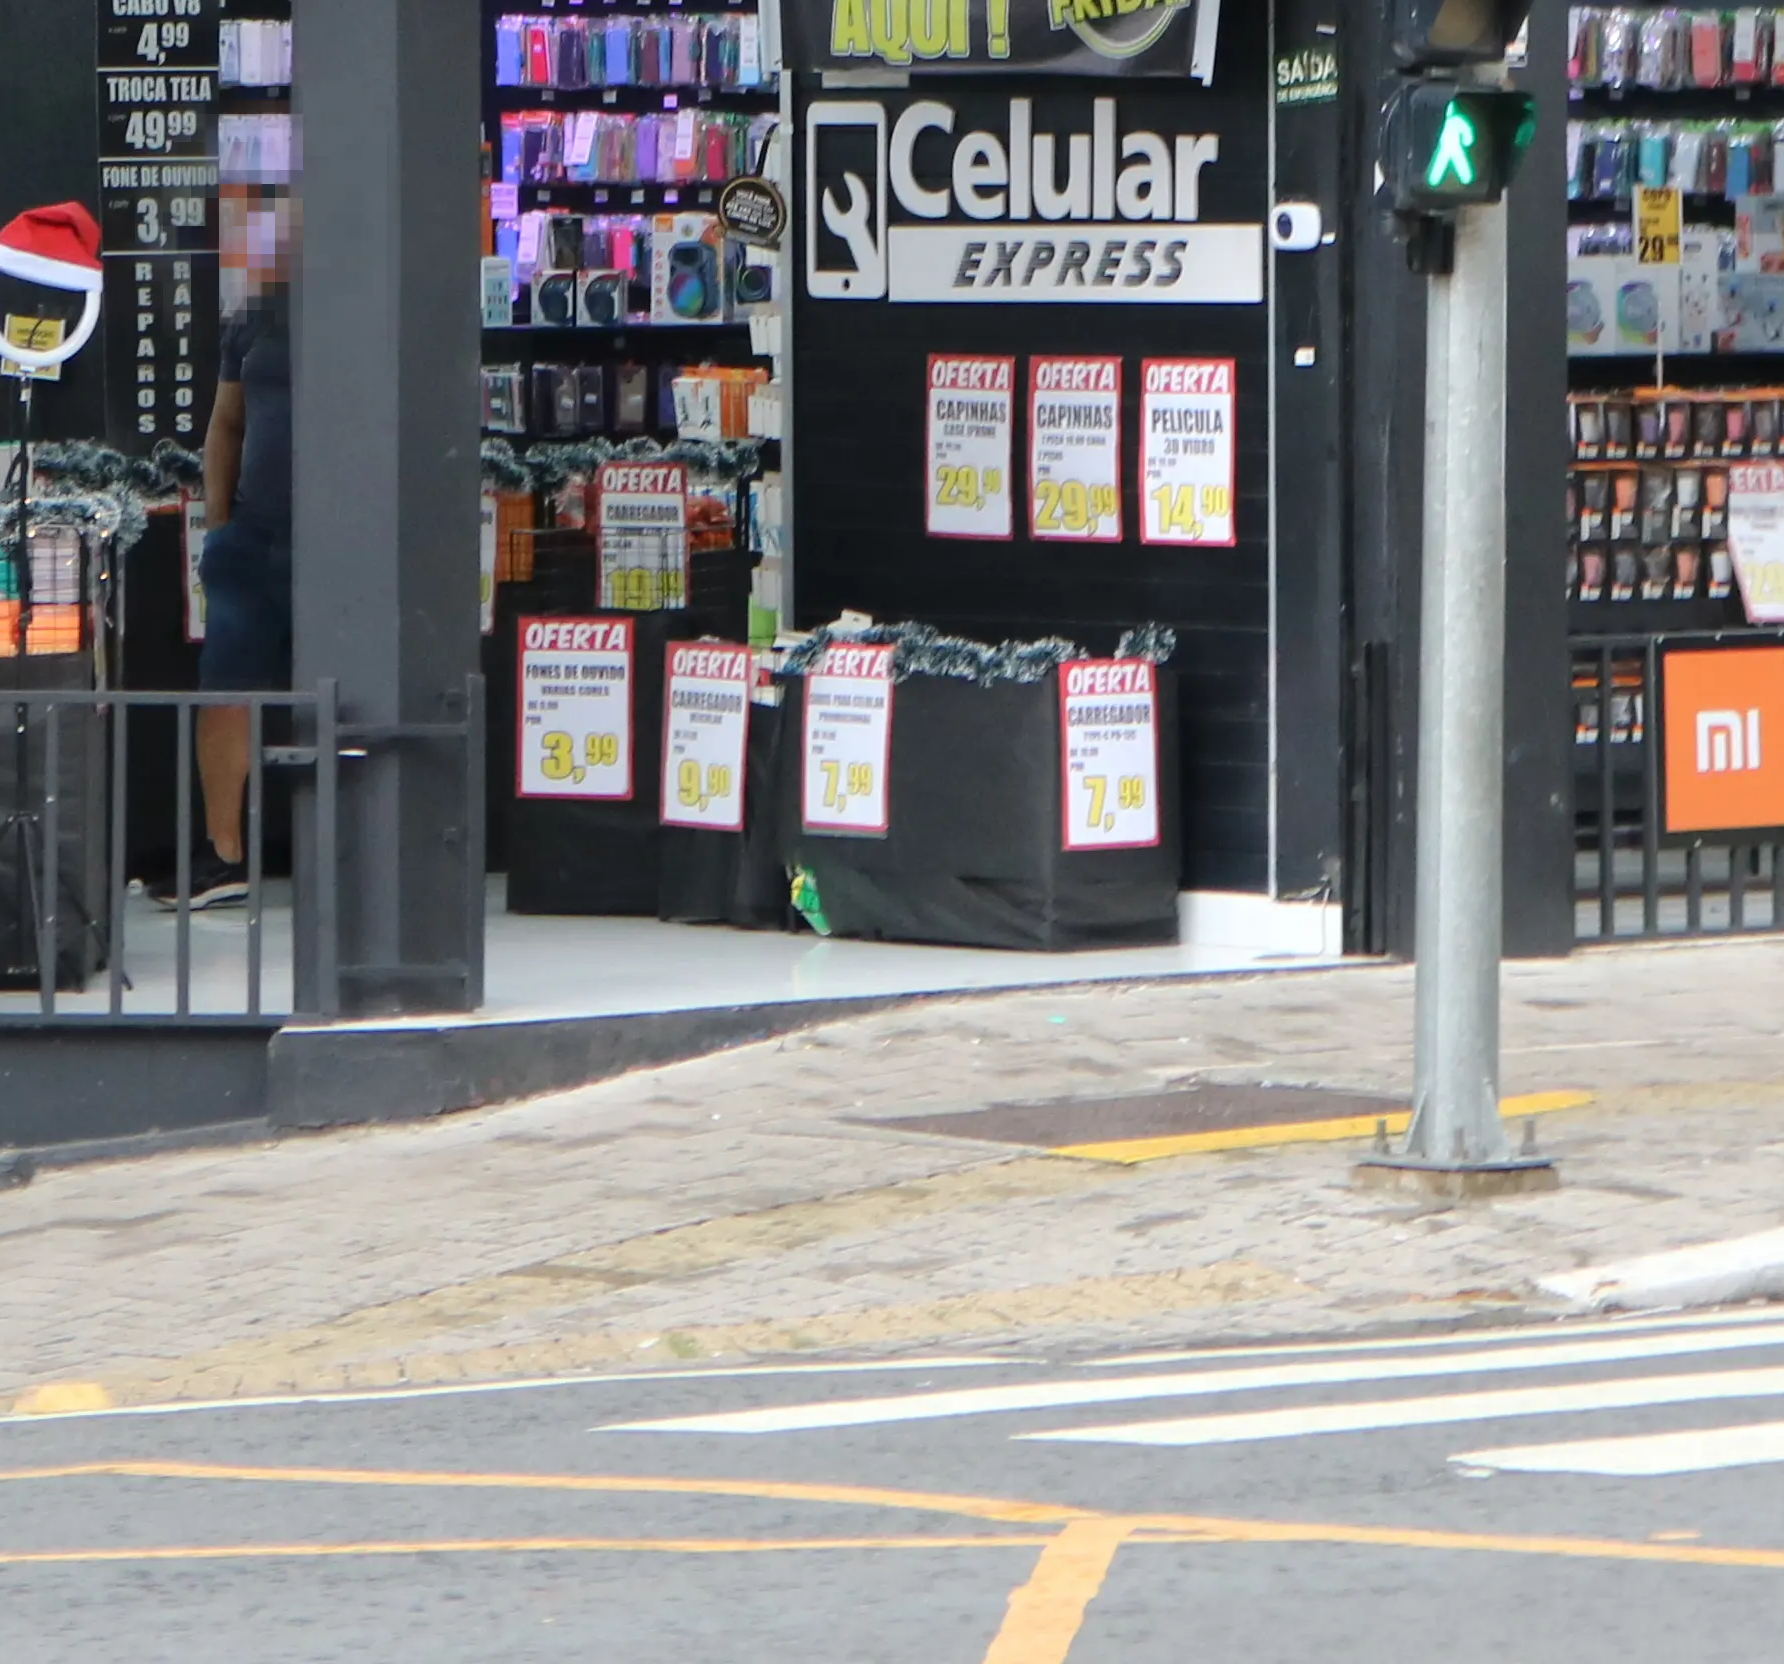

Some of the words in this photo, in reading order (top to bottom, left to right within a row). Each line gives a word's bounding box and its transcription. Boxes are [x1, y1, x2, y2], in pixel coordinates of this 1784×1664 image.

[137, 22, 189, 66] 4,99
[1277, 49, 1338, 86] SAÍDA
[106, 76, 167, 102] TROCA
[169, 76, 212, 102] TELA
[125, 110, 197, 153] 49,99
[889, 99, 1218, 221] Celular
[102, 165, 139, 187] FONE
[140, 165, 160, 186] DE
[161, 165, 218, 187] OUVIDO
[136, 197, 206, 247] 3,99
[952, 240, 1188, 288] EXPRESS
[135, 262, 156, 433] REPAROS
[173, 261, 193, 433] RÁPIDOS
[932, 361, 1010, 389] OFERTA
[1036, 362, 1115, 390] OFERTA
[1146, 364, 1230, 393] OFERTA
[936, 399, 1006, 423] CAPINHAS
[1037, 404, 1112, 430] CAPINHAS
[1151, 407, 1223, 433] PELICULA
[1182, 438, 1215, 455] VIDRO
[603, 467, 682, 493] OFERTA
[1035, 479, 1118, 536] 29,99
[525, 623, 626, 650] OFERTA
[525, 664, 561, 680] FONES
[563, 664, 579, 680] DE
[581, 664, 626, 680] OUVIDO
[672, 648, 746, 680] OFERTA
[821, 648, 889, 678] FERTA
[1067, 664, 1151, 695] OFERTA
[671, 690, 743, 713] CARREGADOR
[1068, 702, 1151, 727] CARREGADOR
[540, 730, 619, 785] 3,99
[820, 759, 873, 813] 7,99
[1083, 774, 1146, 832] 7,99
